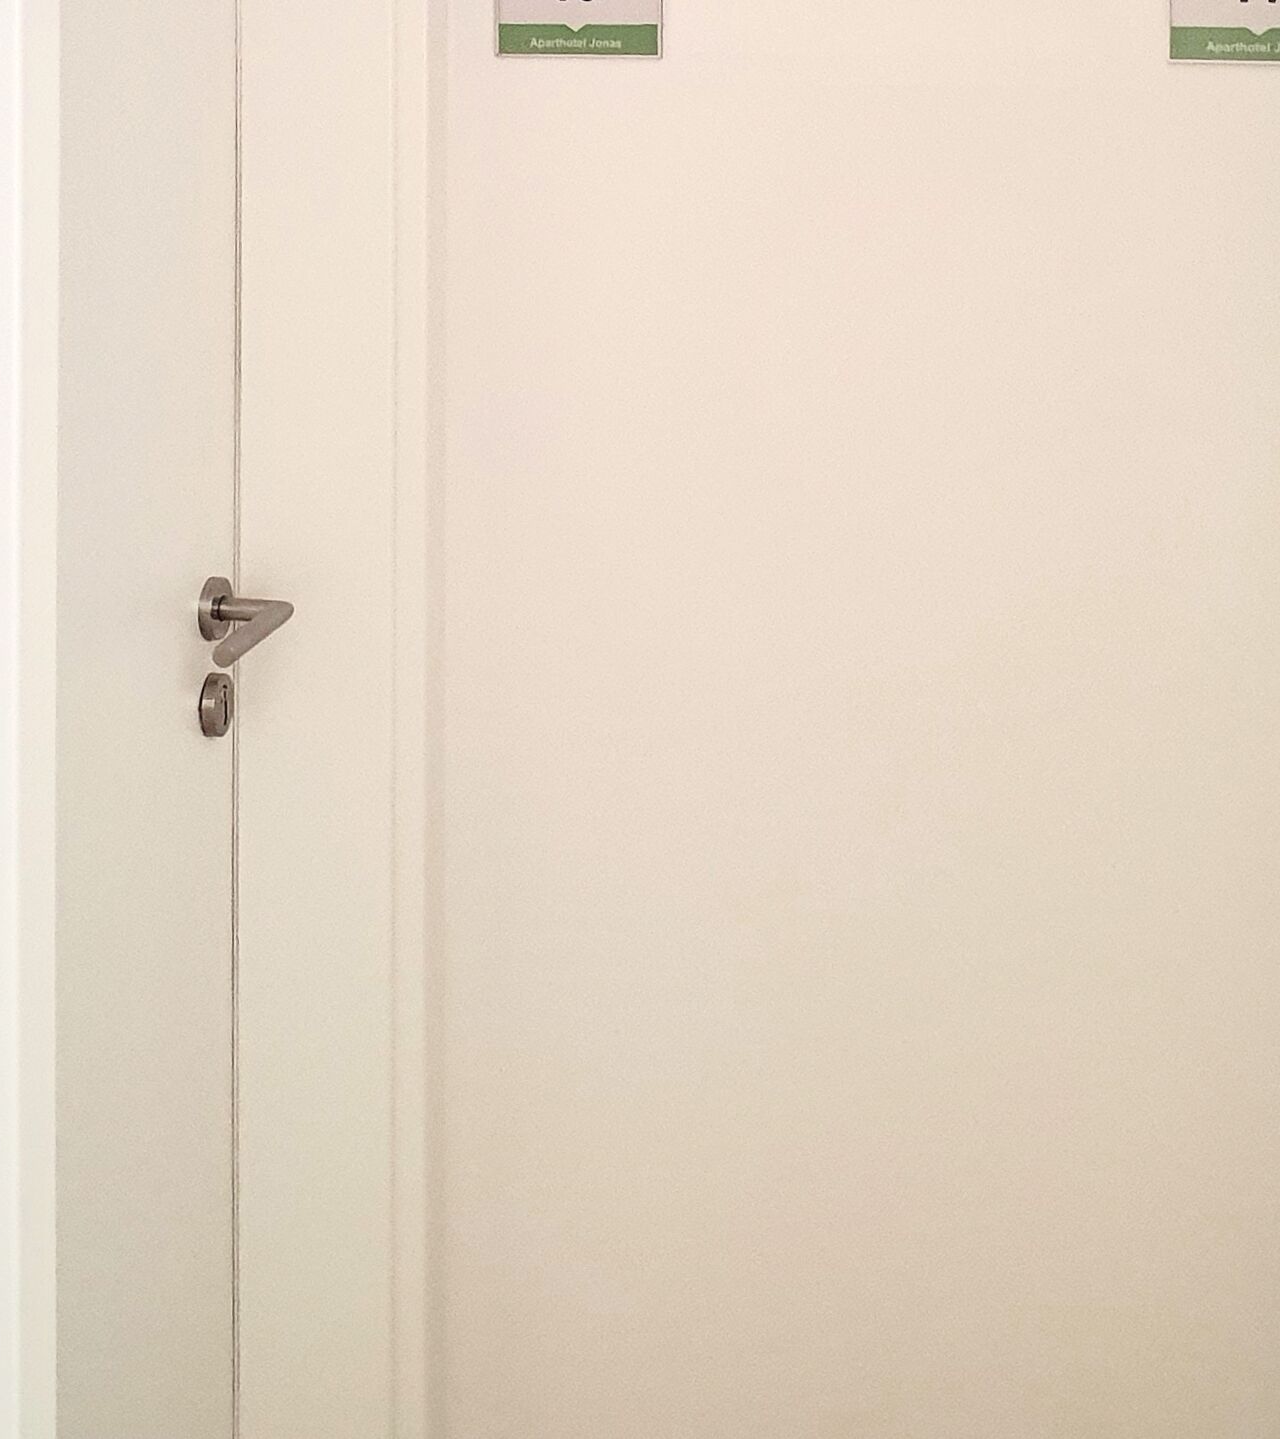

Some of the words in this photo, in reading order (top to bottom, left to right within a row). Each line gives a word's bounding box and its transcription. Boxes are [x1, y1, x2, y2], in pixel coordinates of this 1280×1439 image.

[529, 36, 586, 49] Aparthotel
[589, 37, 621, 48] Jonas
[1206, 41, 1270, 54] Aparthotel
